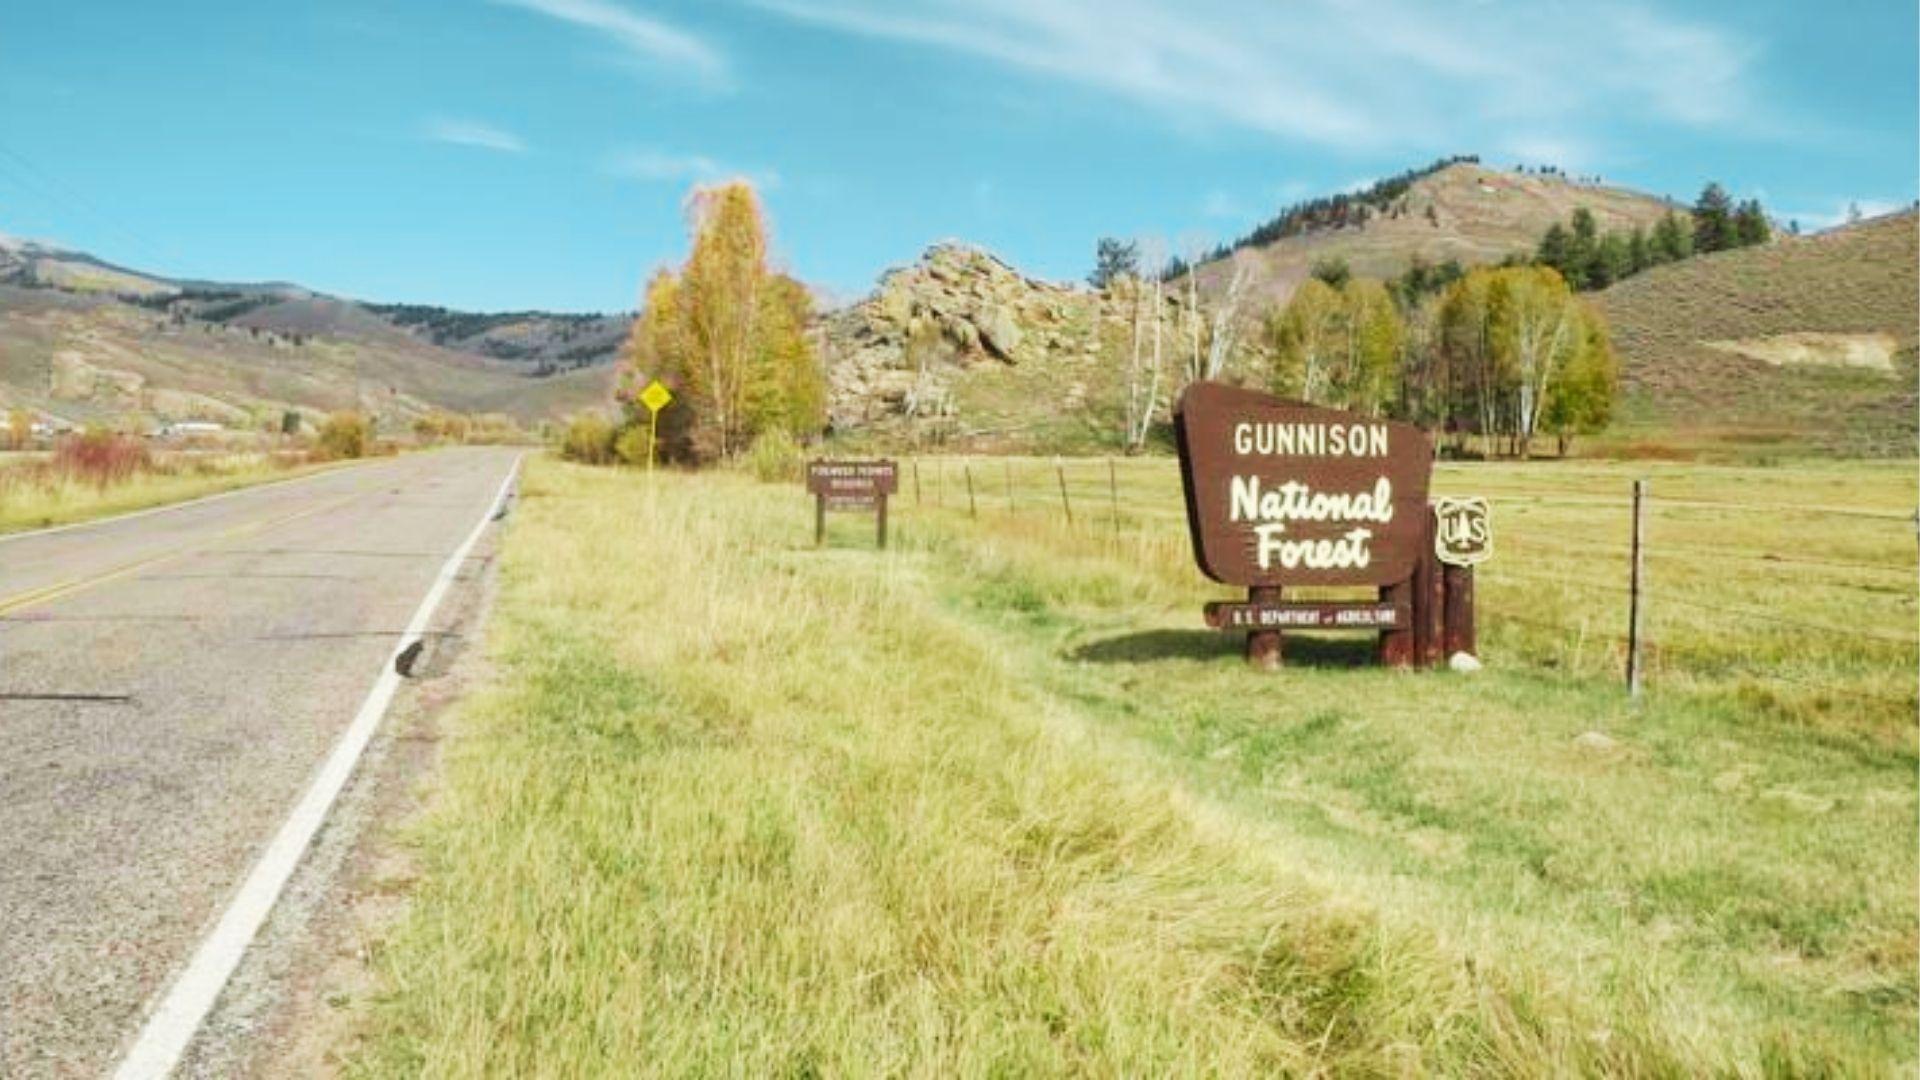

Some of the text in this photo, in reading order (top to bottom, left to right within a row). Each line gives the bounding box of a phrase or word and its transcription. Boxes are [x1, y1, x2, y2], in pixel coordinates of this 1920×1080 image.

[1234, 422, 1388, 457] GUNNISON
[1229, 475, 1393, 523] National
[1254, 523, 1372, 569] Forest
